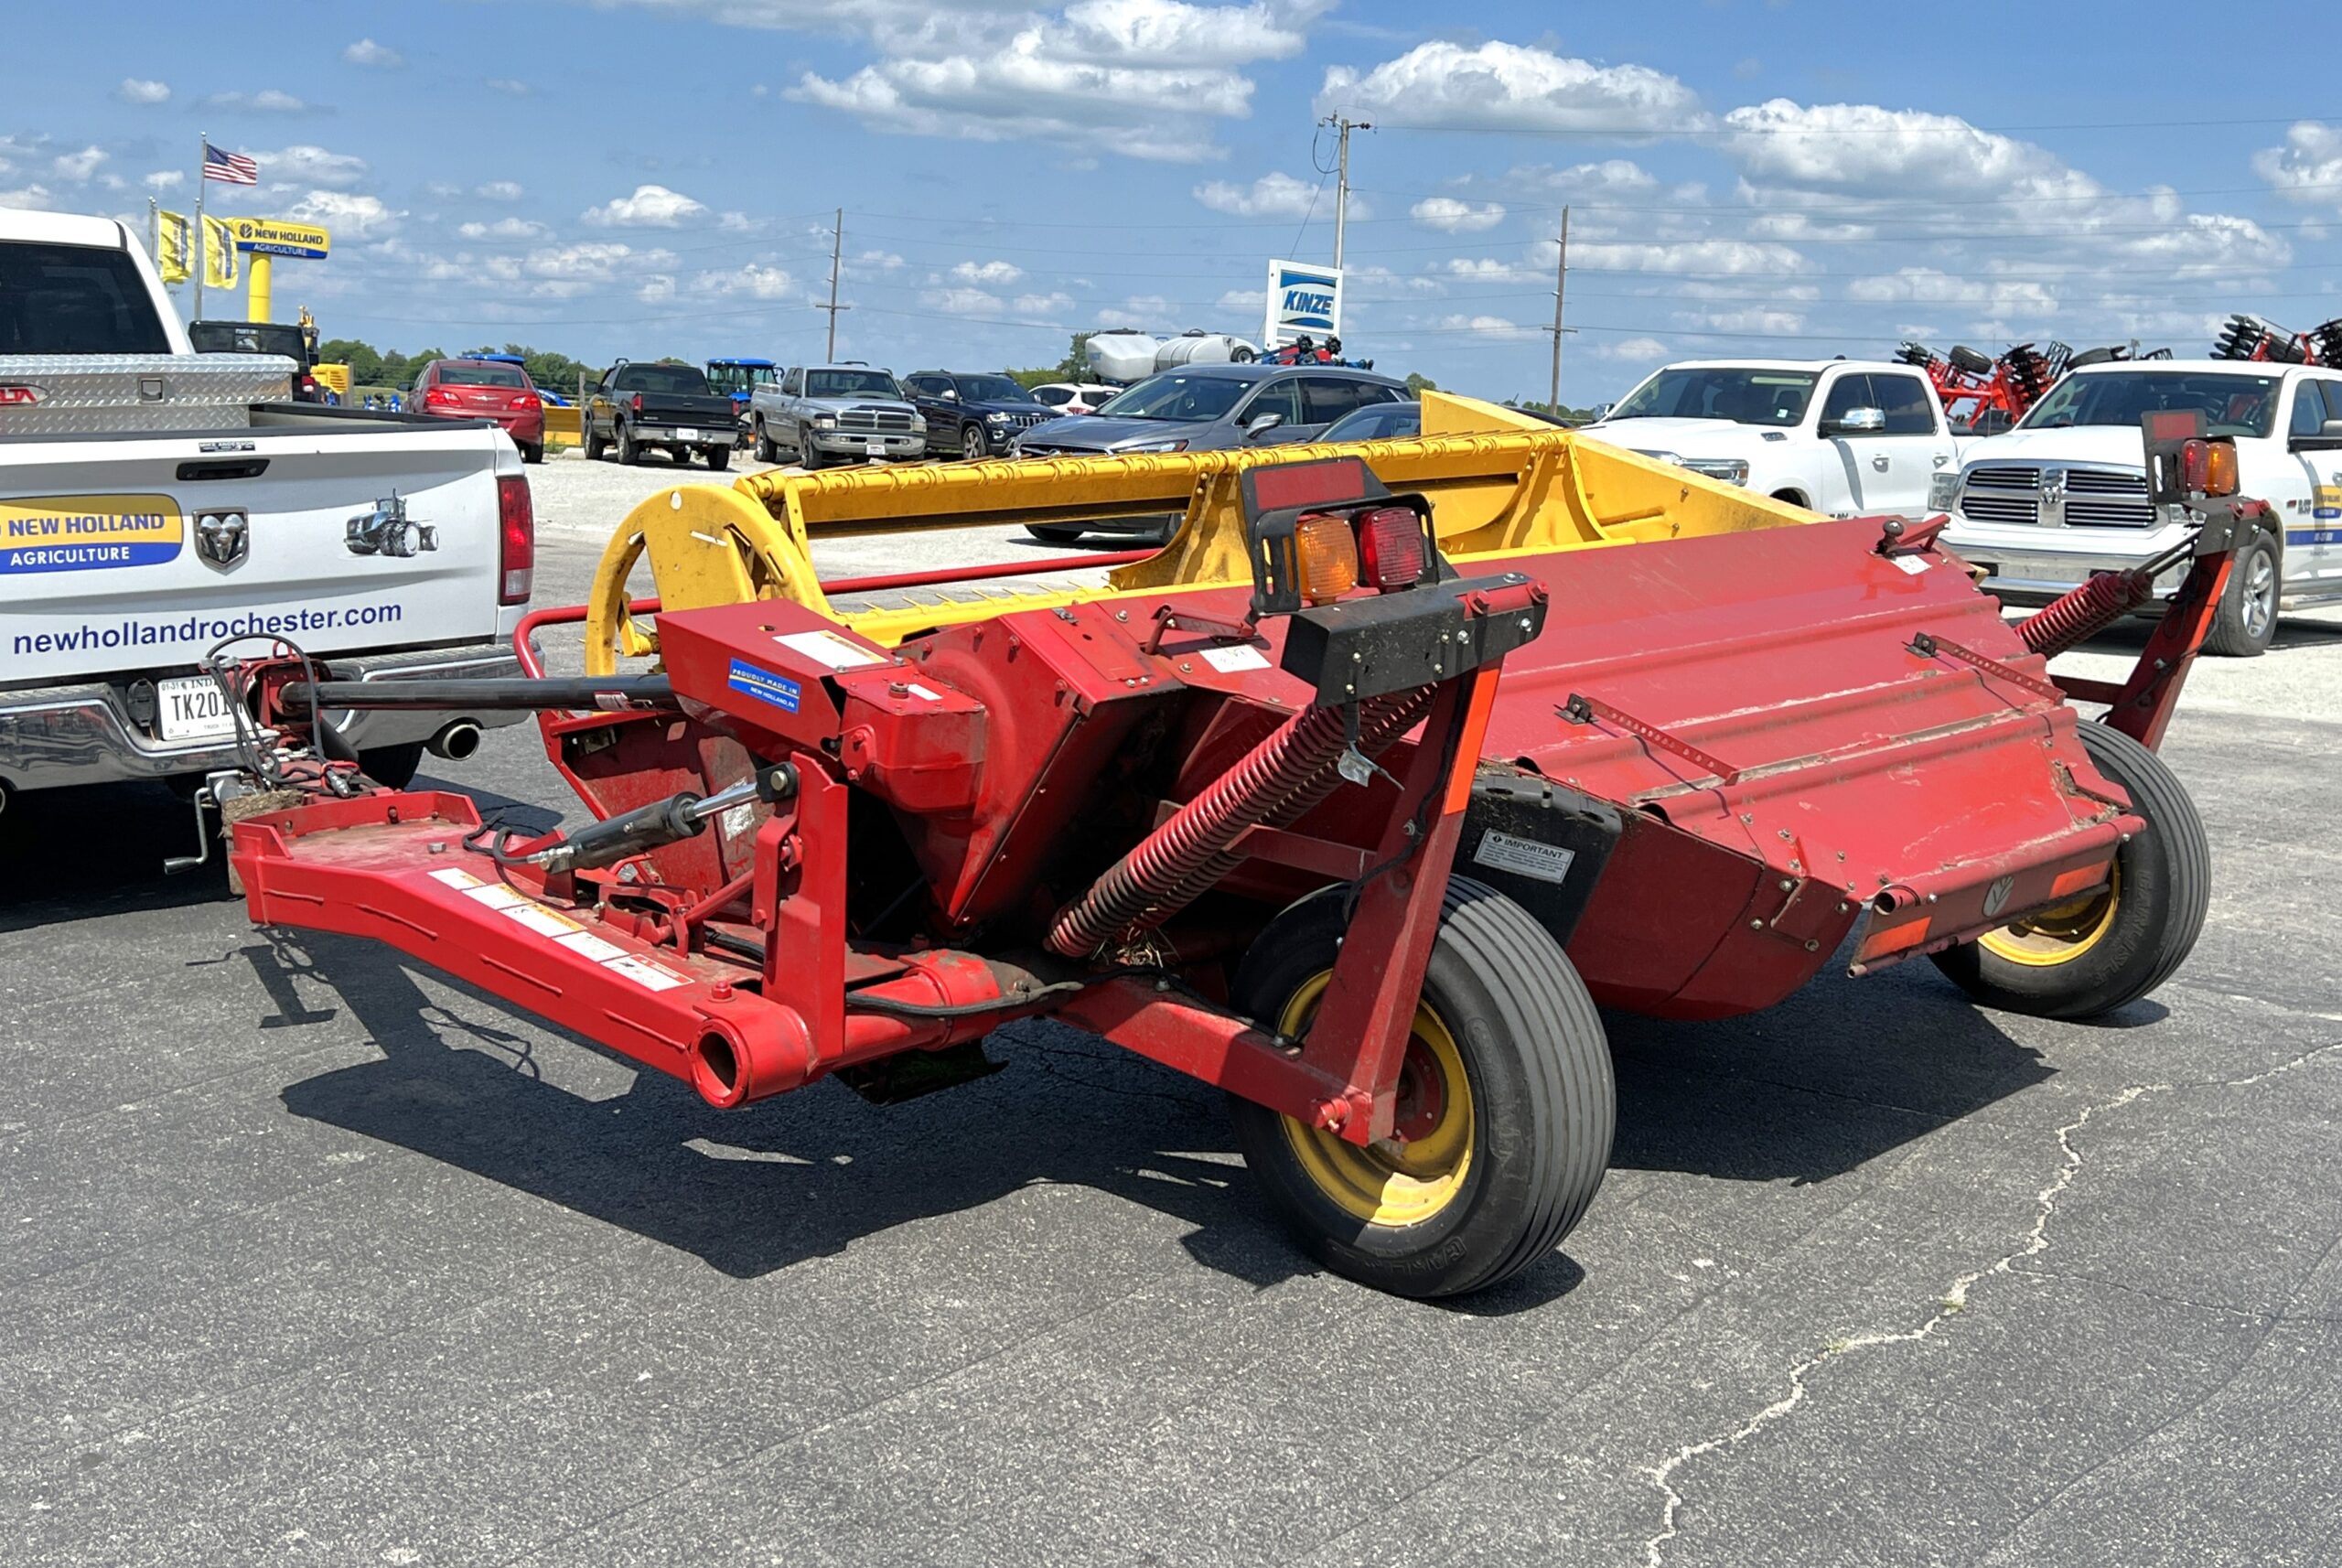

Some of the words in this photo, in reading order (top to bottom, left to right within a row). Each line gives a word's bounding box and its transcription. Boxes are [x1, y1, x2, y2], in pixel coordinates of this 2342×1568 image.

[254, 229, 280, 240] NEW
[280, 231, 324, 245] HOLLAND
[252, 242, 307, 257] AGRICULTURE
[1283, 290, 1335, 316] KINZE
[8, 517, 60, 537] NEW
[65, 513, 166, 534] HOLLAND
[10, 546, 131, 567] AGRICULTURE
[13, 603, 403, 655] newhollandrochester.com
[732, 668, 765, 682] PROUDLY
[767, 679, 787, 691] MADE
[750, 686, 763, 695] NEW
[1504, 837, 1563, 860] IMPORTANT
